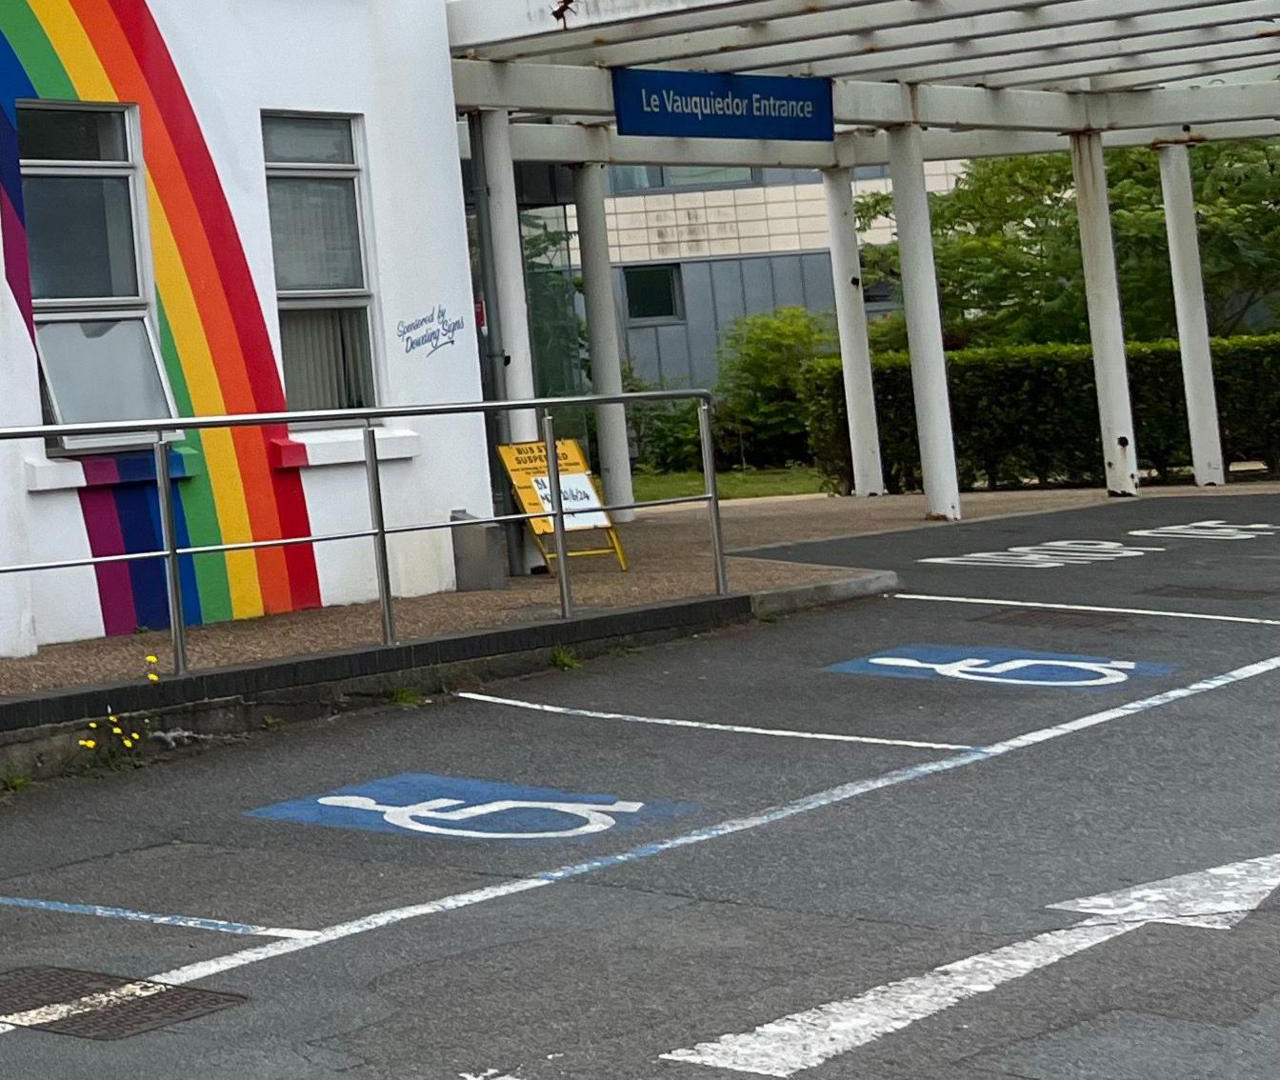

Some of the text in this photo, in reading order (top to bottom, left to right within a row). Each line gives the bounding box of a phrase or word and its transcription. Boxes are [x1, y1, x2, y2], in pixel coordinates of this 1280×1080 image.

[641, 88, 813, 120] Le Vauquiedor Entrance
[397, 304, 447, 342] Sponsored by
[441, 316, 465, 340] Signs
[516, 446, 535, 456] BUS
[914, 539, 1166, 569] DROP
